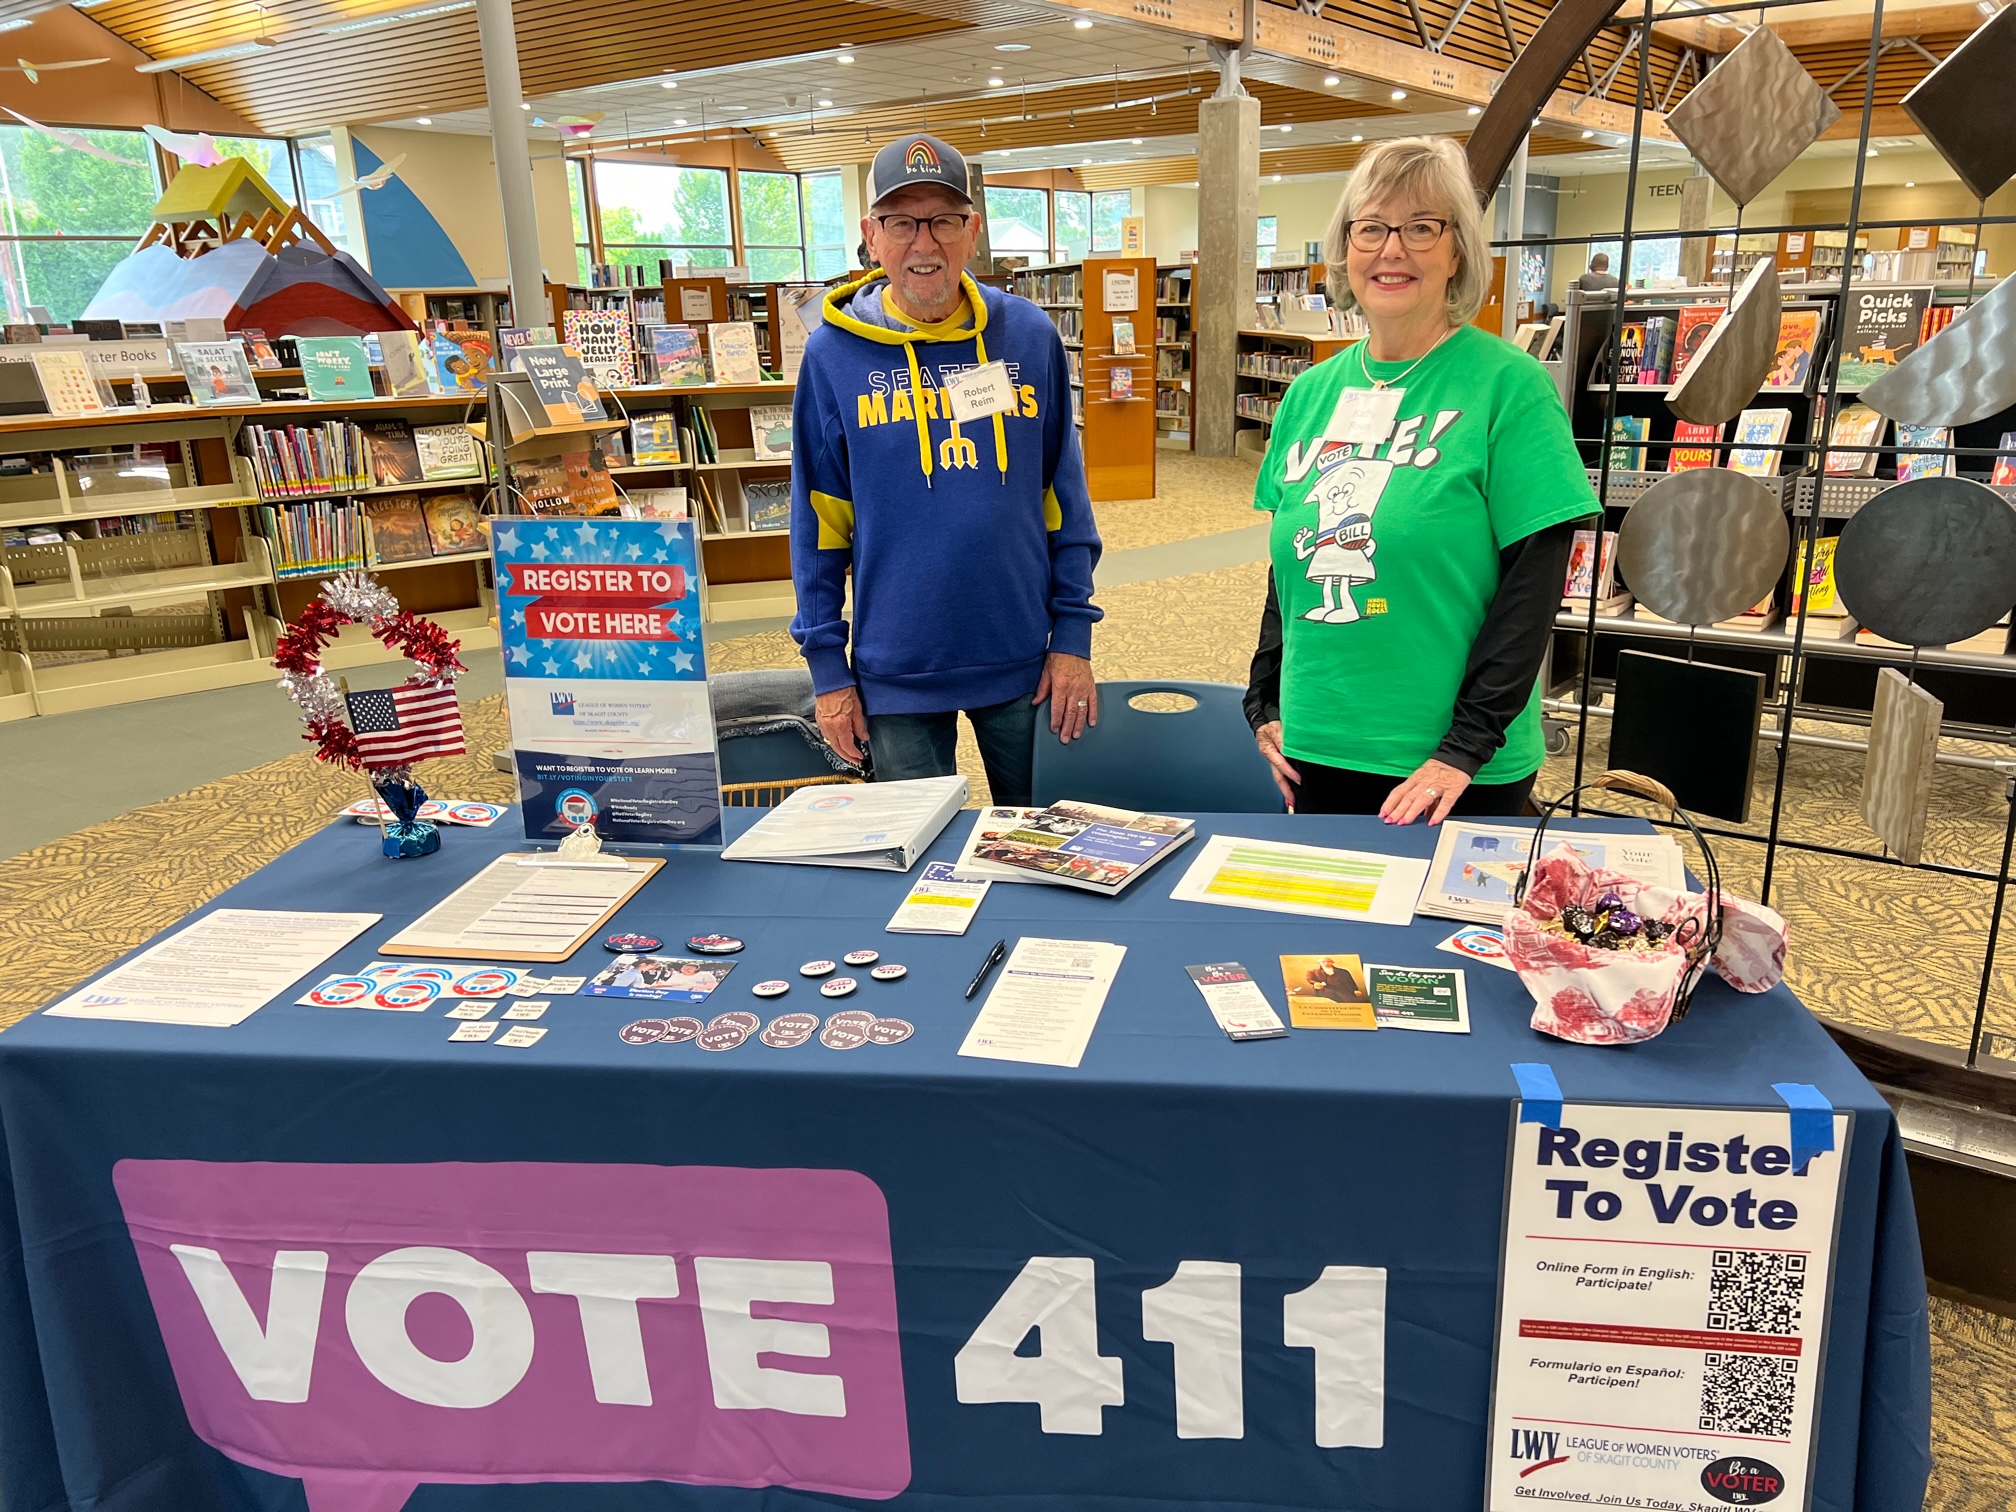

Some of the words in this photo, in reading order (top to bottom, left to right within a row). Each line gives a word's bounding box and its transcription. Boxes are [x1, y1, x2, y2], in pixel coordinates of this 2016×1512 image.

[906, 165, 918, 174] be
[920, 164, 942, 174] kind
[1648, 185, 1684, 198] TEEN
[1860, 293, 1914, 309] Quick
[1859, 308, 1908, 323] Picks
[580, 323, 616, 335] HOW
[1780, 323, 1802, 331] ove,
[503, 334, 526, 347] NEVER
[544, 329, 552, 340] UP
[581, 335, 617, 345] MANY
[581, 345, 618, 355] JELLY
[722, 342, 748, 350] DANCING
[121, 350, 157, 362] Books
[197, 348, 225, 357] SALAT
[206, 355, 233, 363] SECRET
[528, 356, 557, 366] New
[583, 355, 618, 364] BEANS?
[534, 367, 570, 379] Large
[541, 379, 572, 390] Print
[963, 383, 996, 399] Robert
[970, 395, 995, 409] Reim
[375, 422, 394, 431] ADAM
[419, 427, 442, 437] WOO
[1685, 427, 1711, 435] ABBY
[386, 430, 408, 439] TUBA
[440, 434, 470, 446] YOU'RE
[441, 444, 471, 454] DOING
[440, 453, 473, 464] GREAT!
[1319, 446, 1351, 465] VOTE
[1674, 449, 1713, 462] YOURS
[1911, 454, 1942, 464] WHERE
[525, 467, 560, 478] SHADOWS
[567, 465, 589, 474] what
[1925, 463, 1944, 471] YOU
[540, 477, 549, 485] OF
[591, 473, 605, 482] the
[533, 486, 563, 497] PECAN
[571, 486, 606, 497] fireflies
[531, 496, 570, 510] HOLLOW
[594, 497, 616, 506] knew
[1339, 525, 1368, 542] BILL
[1811, 565, 1829, 580] All
[523, 569, 633, 592] REGISTER
[638, 570, 672, 593] TO
[540, 612, 600, 634] VOTE
[605, 613, 662, 635] HERE
[550, 692, 574, 704] LWV
[537, 774, 633, 783] BIT.LY/VOTINGINYOURSTATE
[1622, 849, 1653, 857] Your
[1623, 855, 1653, 863] Vote
[1447, 895, 1471, 904] LWV
[608, 936, 657, 946] VOTER
[1200, 973, 1247, 983] VOTER
[1386, 976, 1440, 985] VOTAN
[82, 994, 127, 1004] LWV
[631, 1025, 662, 1036] VOTE
[670, 1026, 694, 1035] OTE
[779, 1021, 811, 1029] VOTE
[873, 1025, 905, 1036] VOTE
[704, 1031, 740, 1043] VOTE
[831, 1029, 862, 1042] VOTE
[1545, 1179, 1622, 1221] To
[1644, 1183, 1798, 1230] Vote
[1536, 1261, 1580, 1274] Online
[1583, 1263, 1619, 1276] Form
[1623, 1266, 1636, 1277] in
[1638, 1267, 1696, 1281] English:
[1575, 1277, 1653, 1292] Participate!
[170, 1244, 847, 1417] VOTE
[954, 1256, 1388, 1449] 411
[1529, 1358, 1602, 1373] Formulario
[1605, 1365, 1622, 1374] en
[1625, 1365, 1686, 1380] Español:
[1567, 1373, 1640, 1389] Participen!
[1510, 1428, 1560, 1460] LWV
[1566, 1436, 1610, 1451] LEAGUE
[1611, 1442, 1625, 1452] OF
[1626, 1442, 1671, 1457] WOMEN
[1577, 1451, 1593, 1463] OF
[1593, 1452, 1632, 1466] SKAGIT
[1633, 1456, 1681, 1471] COUNTY
[1728, 1461, 1748, 1476] Be
[1749, 1466, 1760, 1476] a
[1706, 1470, 1780, 1493] VOTER
[1515, 1486, 1536, 1497] Get
[1538, 1488, 1592, 1502] Involved.
[1595, 1493, 1623, 1505] Join
[1625, 1496, 1641, 1506] Us
[1645, 1498, 1686, 1511] Today.
